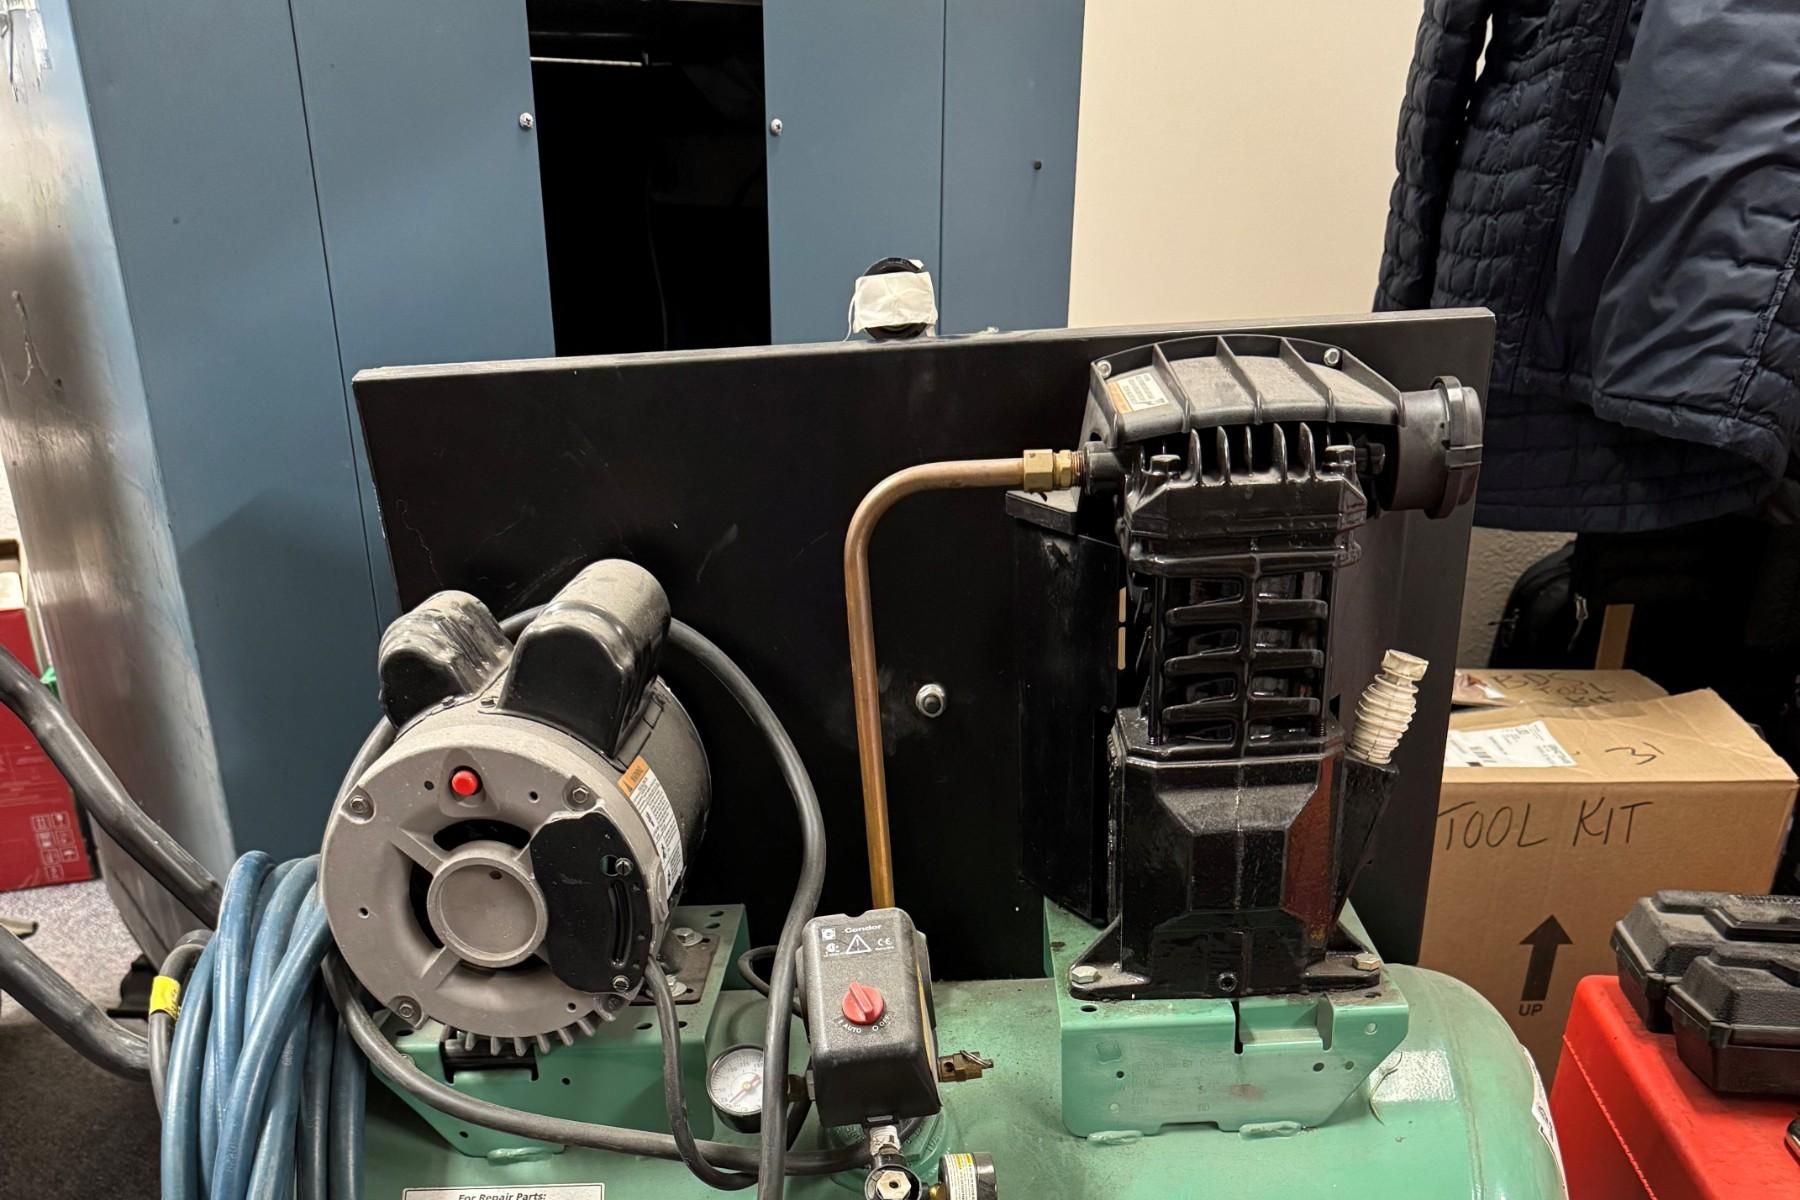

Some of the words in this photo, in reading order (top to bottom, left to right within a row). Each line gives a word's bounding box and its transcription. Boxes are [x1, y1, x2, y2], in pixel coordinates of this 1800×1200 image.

[1438, 800, 1547, 850] TOOL
[1573, 797, 1653, 847] KIT
[1519, 1003, 1543, 1017] UP
[516, 1192, 547, 1200] Parts:
